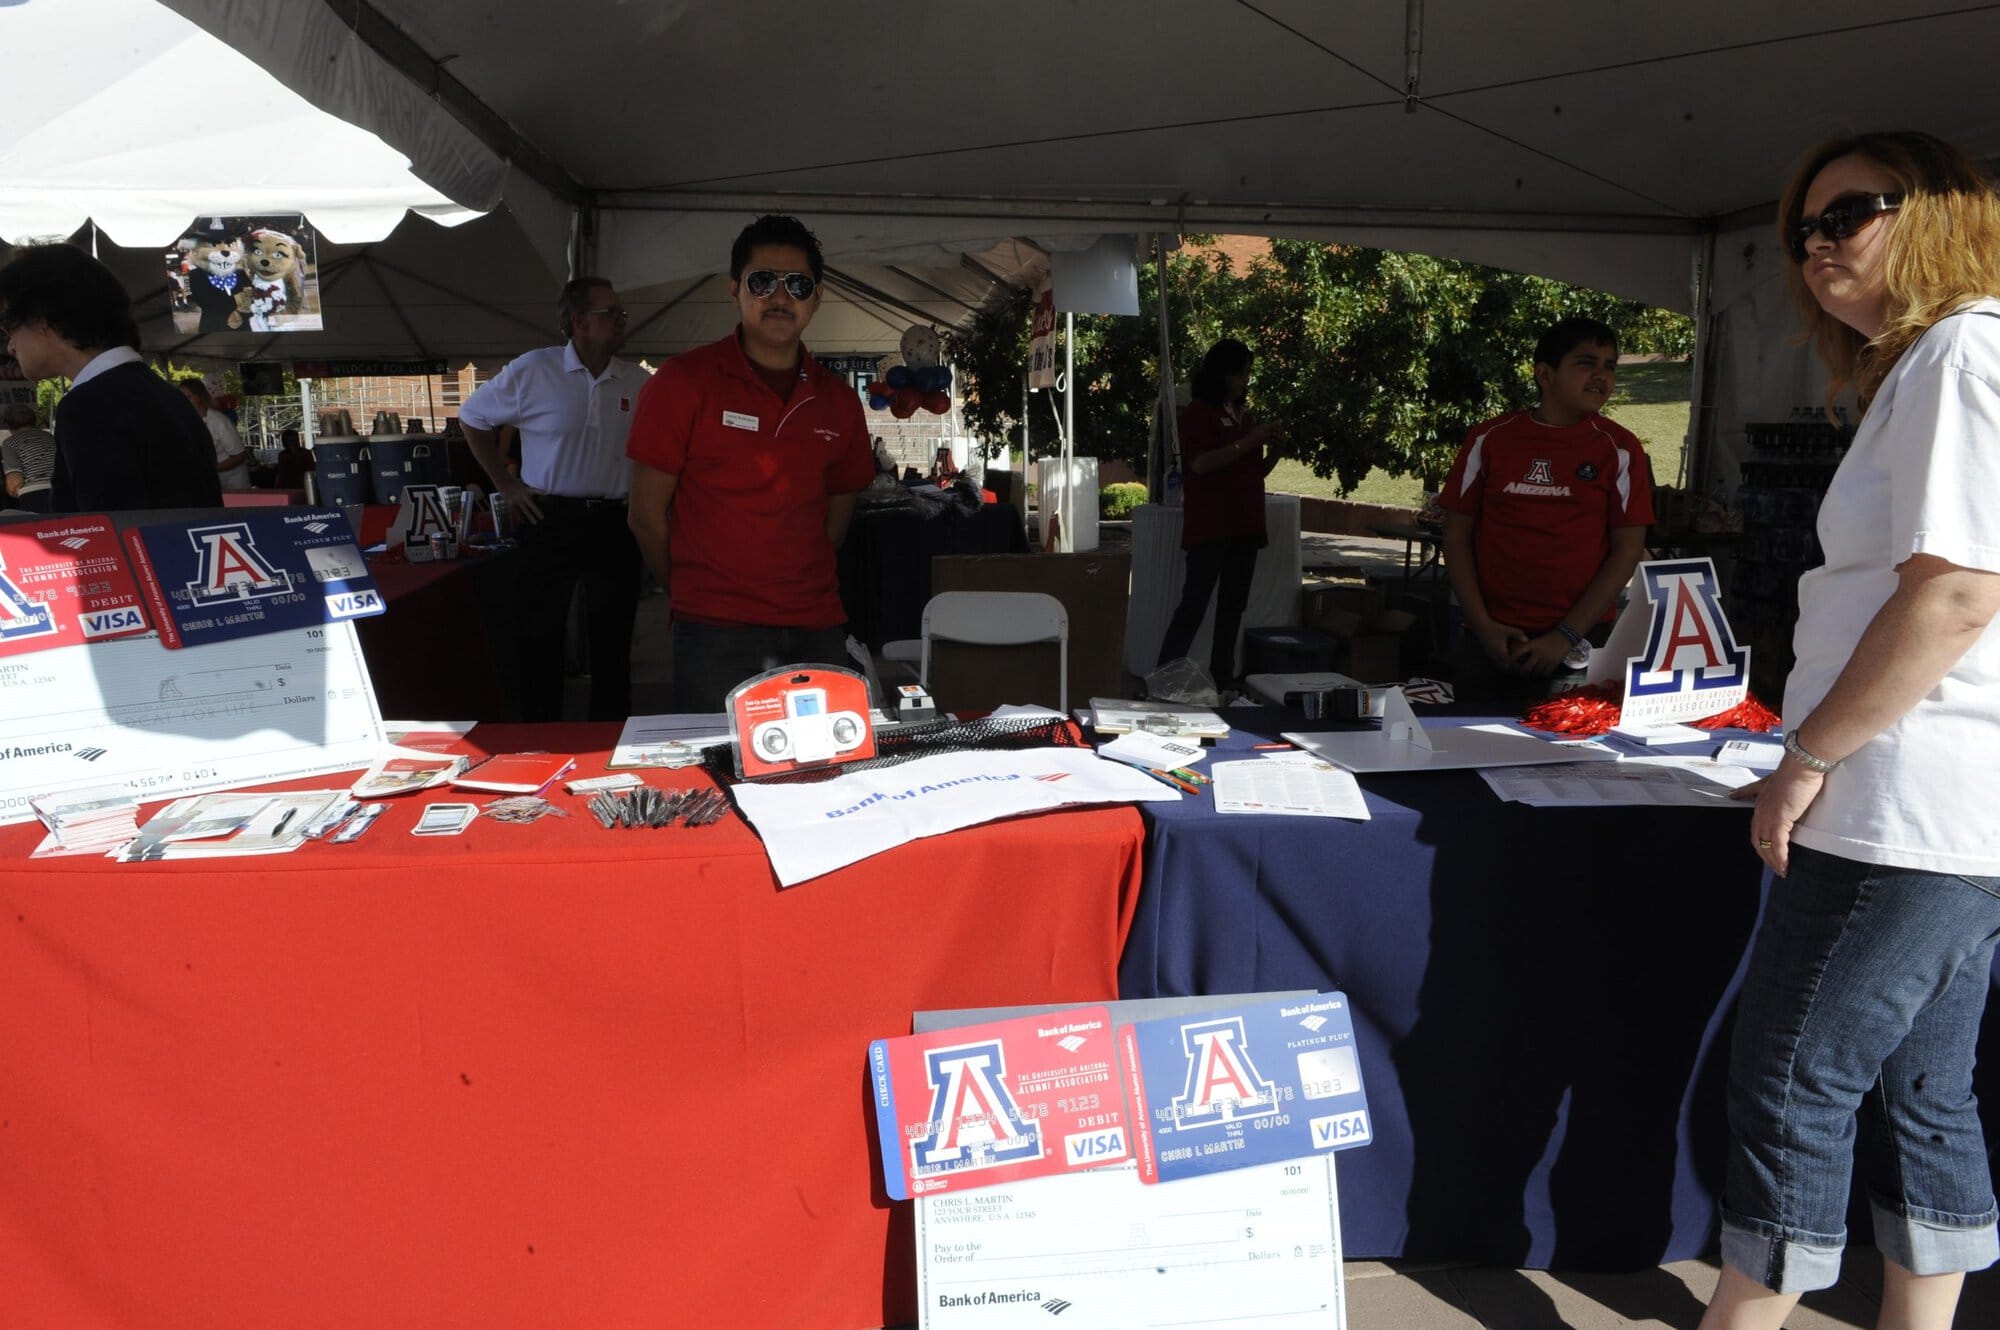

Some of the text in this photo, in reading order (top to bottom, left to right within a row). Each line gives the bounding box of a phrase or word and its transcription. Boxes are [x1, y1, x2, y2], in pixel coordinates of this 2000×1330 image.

[1525, 459, 1554, 484] A
[1503, 481, 1571, 497] ARIZONA
[283, 515, 303, 524] Bank
[311, 511, 341, 521] America
[404, 484, 459, 546] A
[37, 529, 60, 540] Bank
[68, 525, 105, 536] America
[294, 536, 331, 547] PLATINUM
[186, 523, 294, 608] A
[22, 565, 118, 584] ALUMNI ASSOCIATION
[90, 594, 133, 609] DEBIT
[271, 593, 306, 606] 00/00
[334, 594, 378, 613] VISA
[86, 610, 141, 632] VISA
[182, 611, 266, 632] CHRIS L MARTIN
[1629, 560, 1747, 697] A
[306, 630, 324, 639] 101
[277, 677, 287, 688] $
[283, 694, 317, 706] Dollars
[1645, 693, 1691, 704] UNIVERSITY
[1709, 688, 1742, 698] ARIZONA
[1625, 697, 1742, 717] ALUMNI ASSOCIATION
[13, 742, 73, 758] America
[826, 773, 1021, 819] Bank of America
[1280, 1001, 1341, 1017] Bank of America
[1038, 1021, 1102, 1038] Bank of America
[1287, 1036, 1326, 1048] PLATINUM
[1126, 1034, 1137, 1073] Association
[875, 1046, 890, 1107] CHECK CARD
[1032, 1068, 1067, 1080] UNIVERSITY
[1080, 1062, 1107, 1072] ARIZONA
[1172, 1016, 1280, 1131] A
[1019, 1073, 1109, 1094] ALUMNI ASSOCIATION
[1131, 1073, 1140, 1096] Alumni
[1304, 1079, 1342, 1096] 9123
[908, 1038, 1045, 1178] A
[1057, 1094, 1101, 1113] 9123
[1136, 1096, 1145, 1121] Arizona
[1079, 1112, 1119, 1128] DEBIT
[1225, 1122, 1243, 1130] VALID
[1254, 1115, 1290, 1130] 00/00
[1318, 1117, 1366, 1141] VISA
[1073, 1133, 1122, 1158] VISA
[1140, 1130, 1151, 1161] University
[1161, 1138, 1246, 1162] CHRIS L MARTIN
[1145, 1160, 1153, 1176] The
[1284, 1166, 1302, 1176] 101
[933, 1197, 963, 1208] CHRIS
[975, 1194, 1013, 1205] MARTIN
[934, 1204, 1003, 1217] 123 YOUR STREET
[1016, 1210, 1037, 1220] 12345
[1246, 1209, 1263, 1217] Date
[1245, 1226, 1255, 1239] $
[935, 1241, 982, 1254] Pay to the
[1248, 1250, 1281, 1261] Dollars
[934, 1252, 976, 1264] Order of
[939, 1290, 1041, 1307] Bank of America
